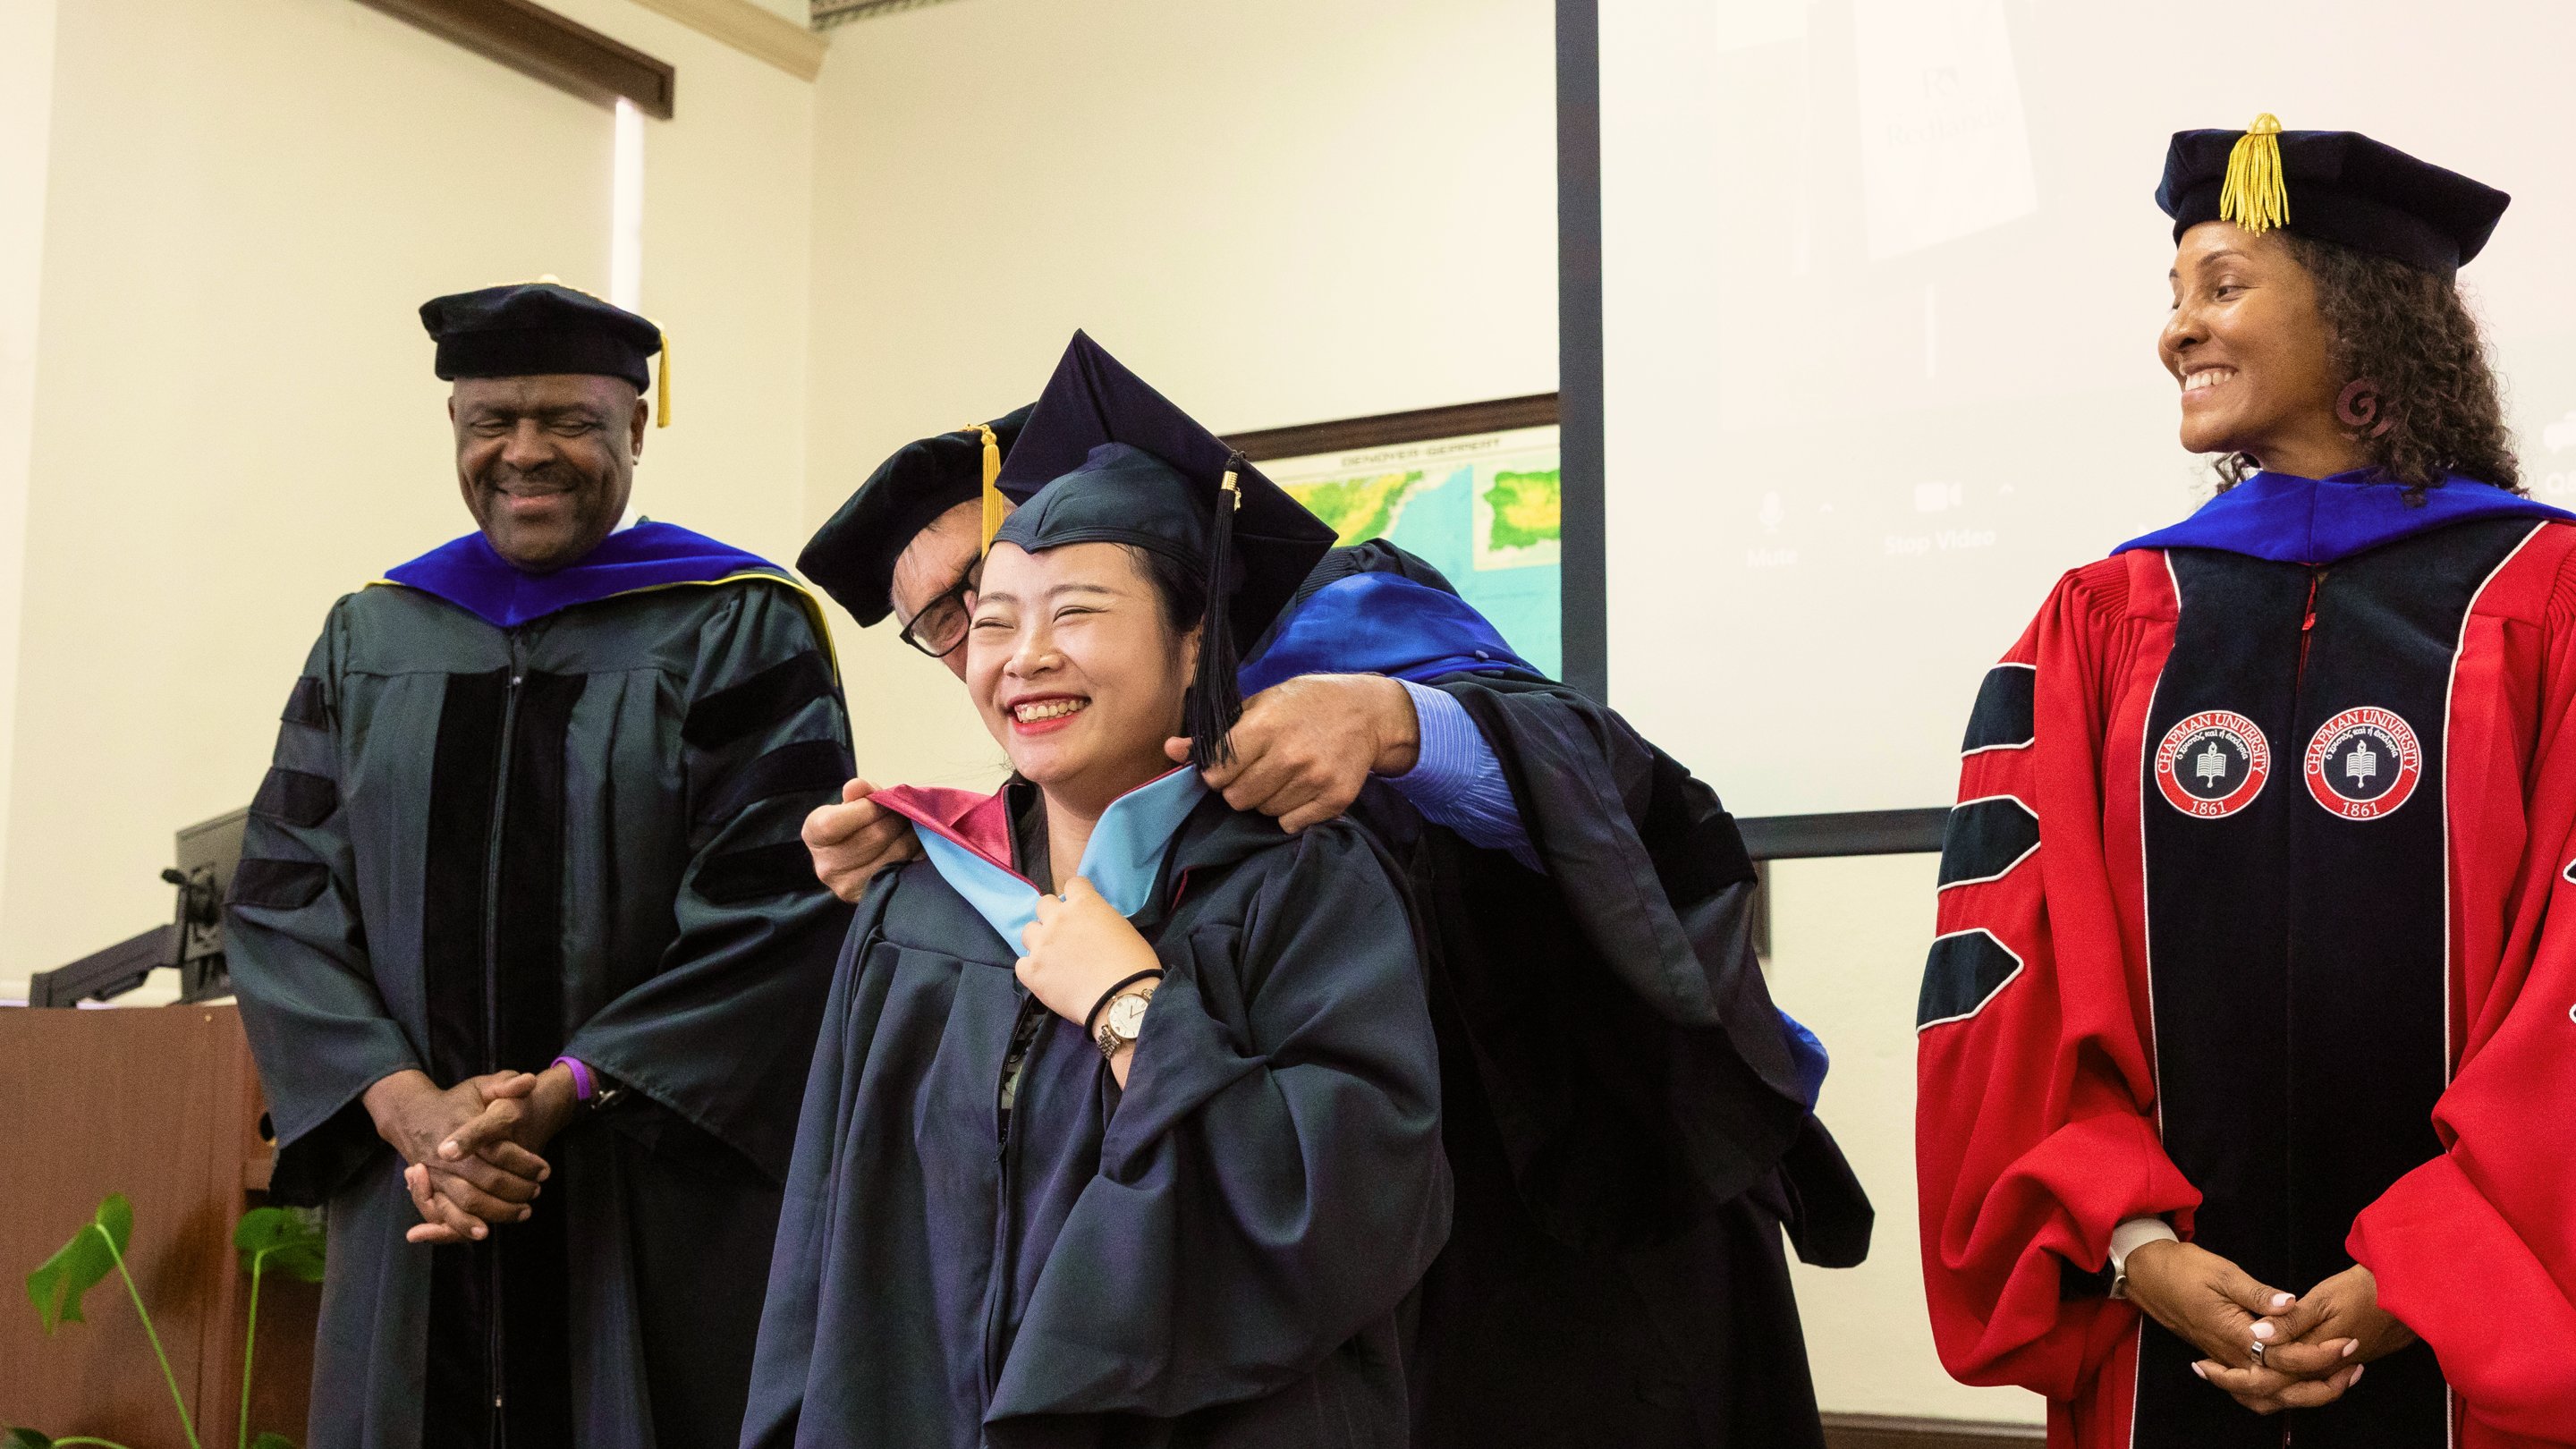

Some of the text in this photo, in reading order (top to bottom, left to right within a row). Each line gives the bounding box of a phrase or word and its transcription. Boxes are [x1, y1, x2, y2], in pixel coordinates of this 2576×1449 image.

[1885, 103, 2006, 149] Redlands
[1884, 528, 1996, 556] Stop Video
[1746, 547, 1798, 568] Mute
[2157, 713, 2267, 775] CHAPMAN UNIVERSITY
[2308, 709, 2419, 775] CHAPMAN UNIVERSITY
[2190, 801, 2227, 816] 1861
[2341, 801, 2380, 817] 1861
